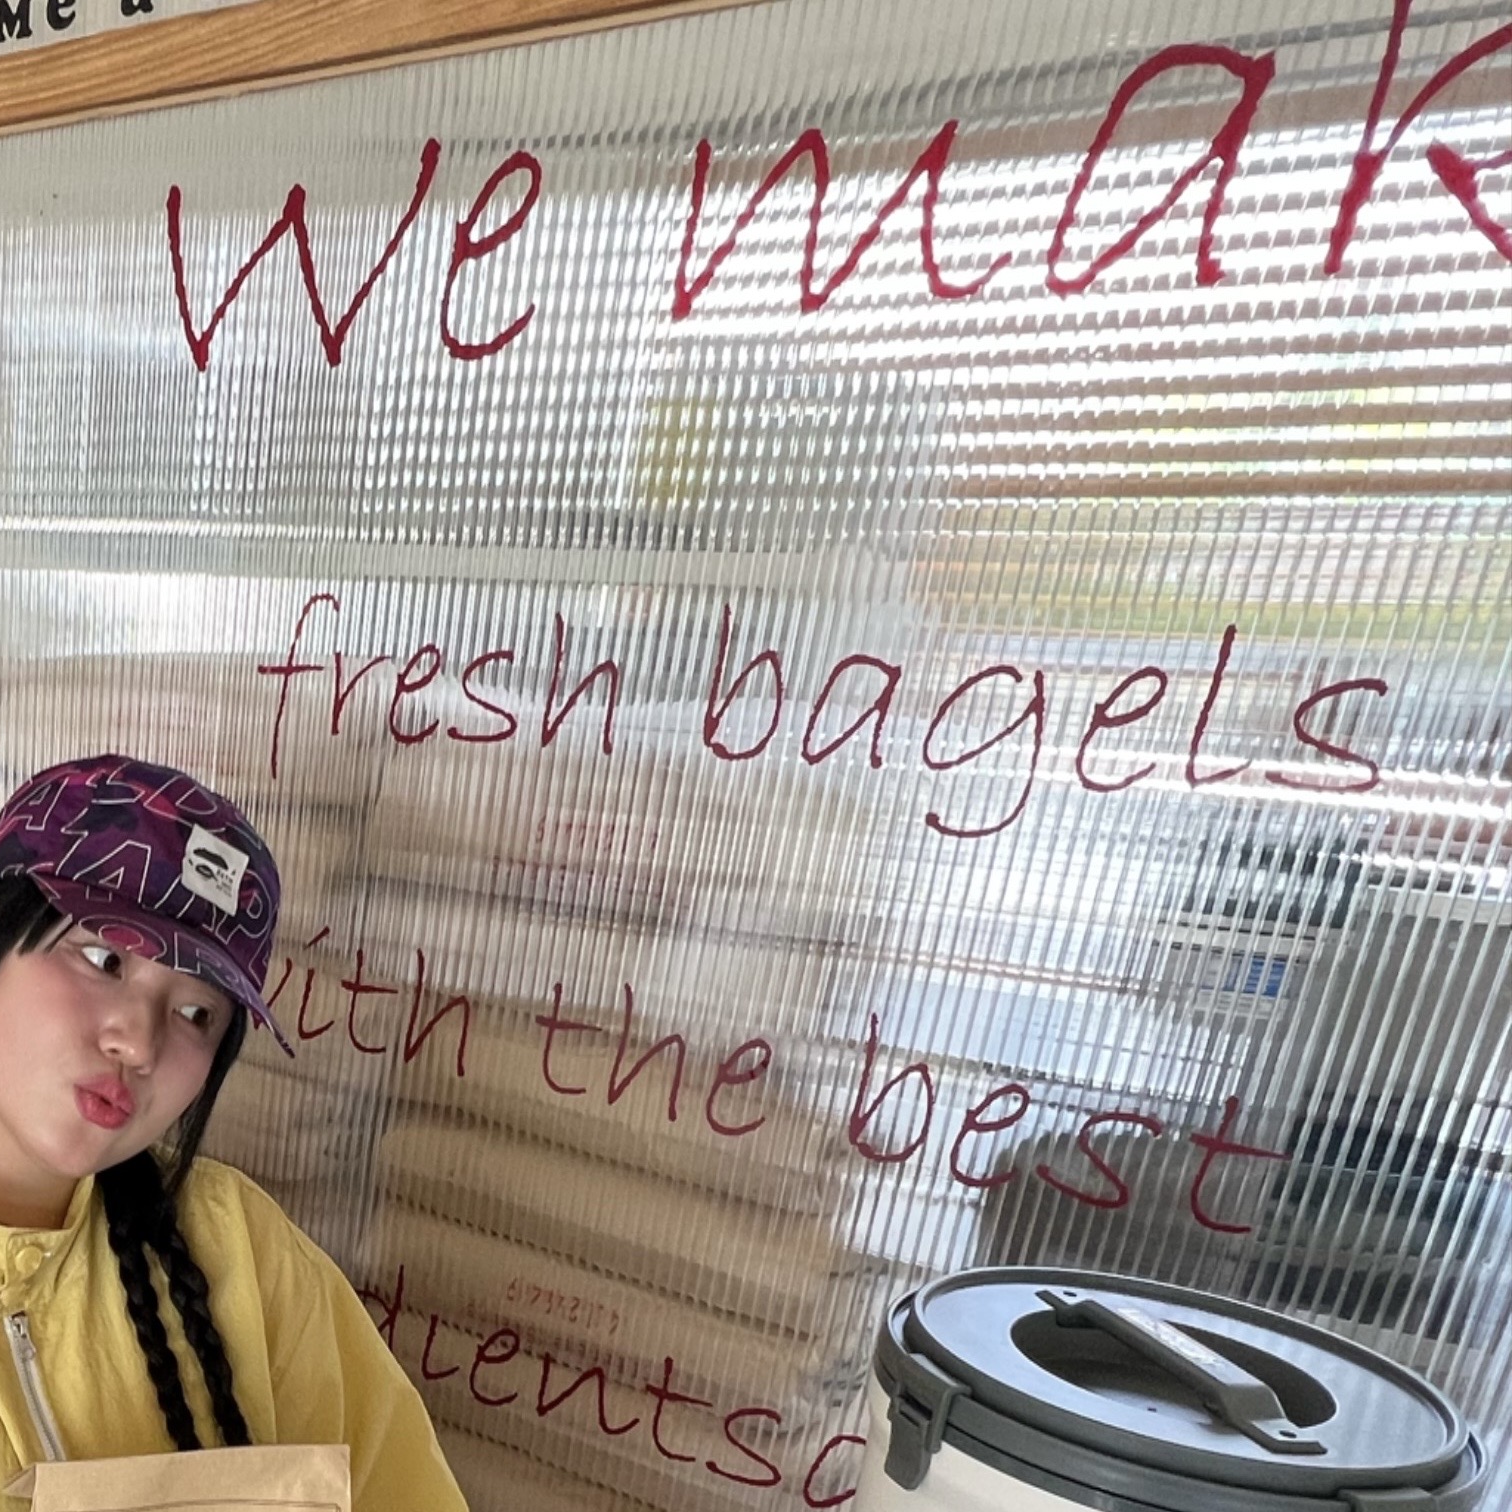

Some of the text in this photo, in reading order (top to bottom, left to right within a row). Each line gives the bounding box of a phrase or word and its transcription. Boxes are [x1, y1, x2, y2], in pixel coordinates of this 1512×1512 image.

[257, 592, 1389, 838] fresh bagels
[534, 981, 774, 1137] the
[848, 1012, 1292, 1234] best
